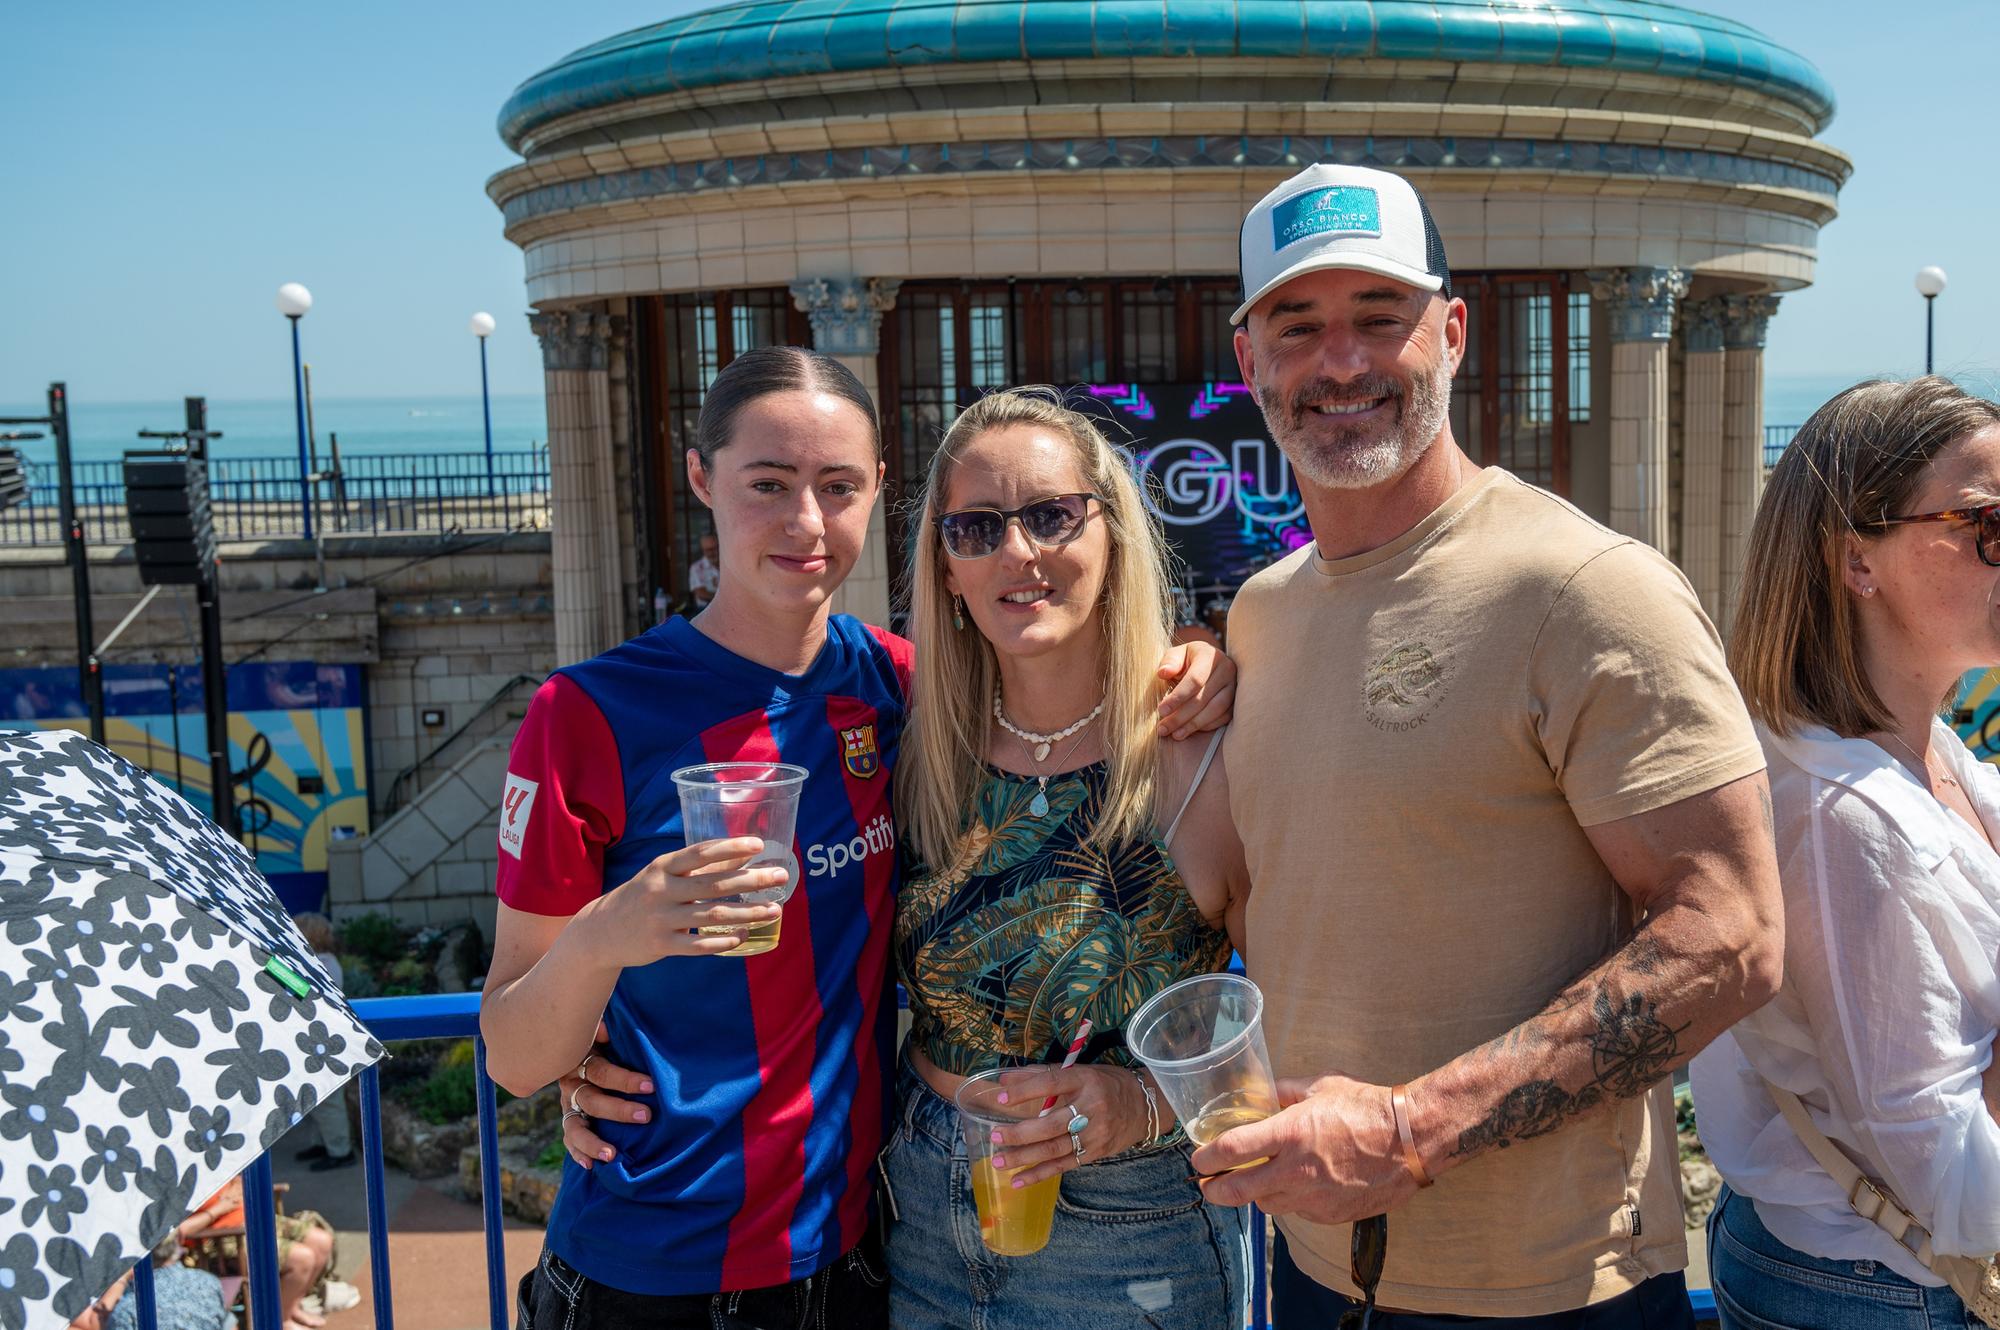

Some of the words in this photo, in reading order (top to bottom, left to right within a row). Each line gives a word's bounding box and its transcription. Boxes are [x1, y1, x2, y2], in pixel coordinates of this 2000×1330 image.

[1283, 218, 1314, 236] ORSO
[1319, 213, 1368, 223] BIANCO
[1365, 712, 1427, 733] SALTROCK
[807, 814, 895, 879] Spotify
